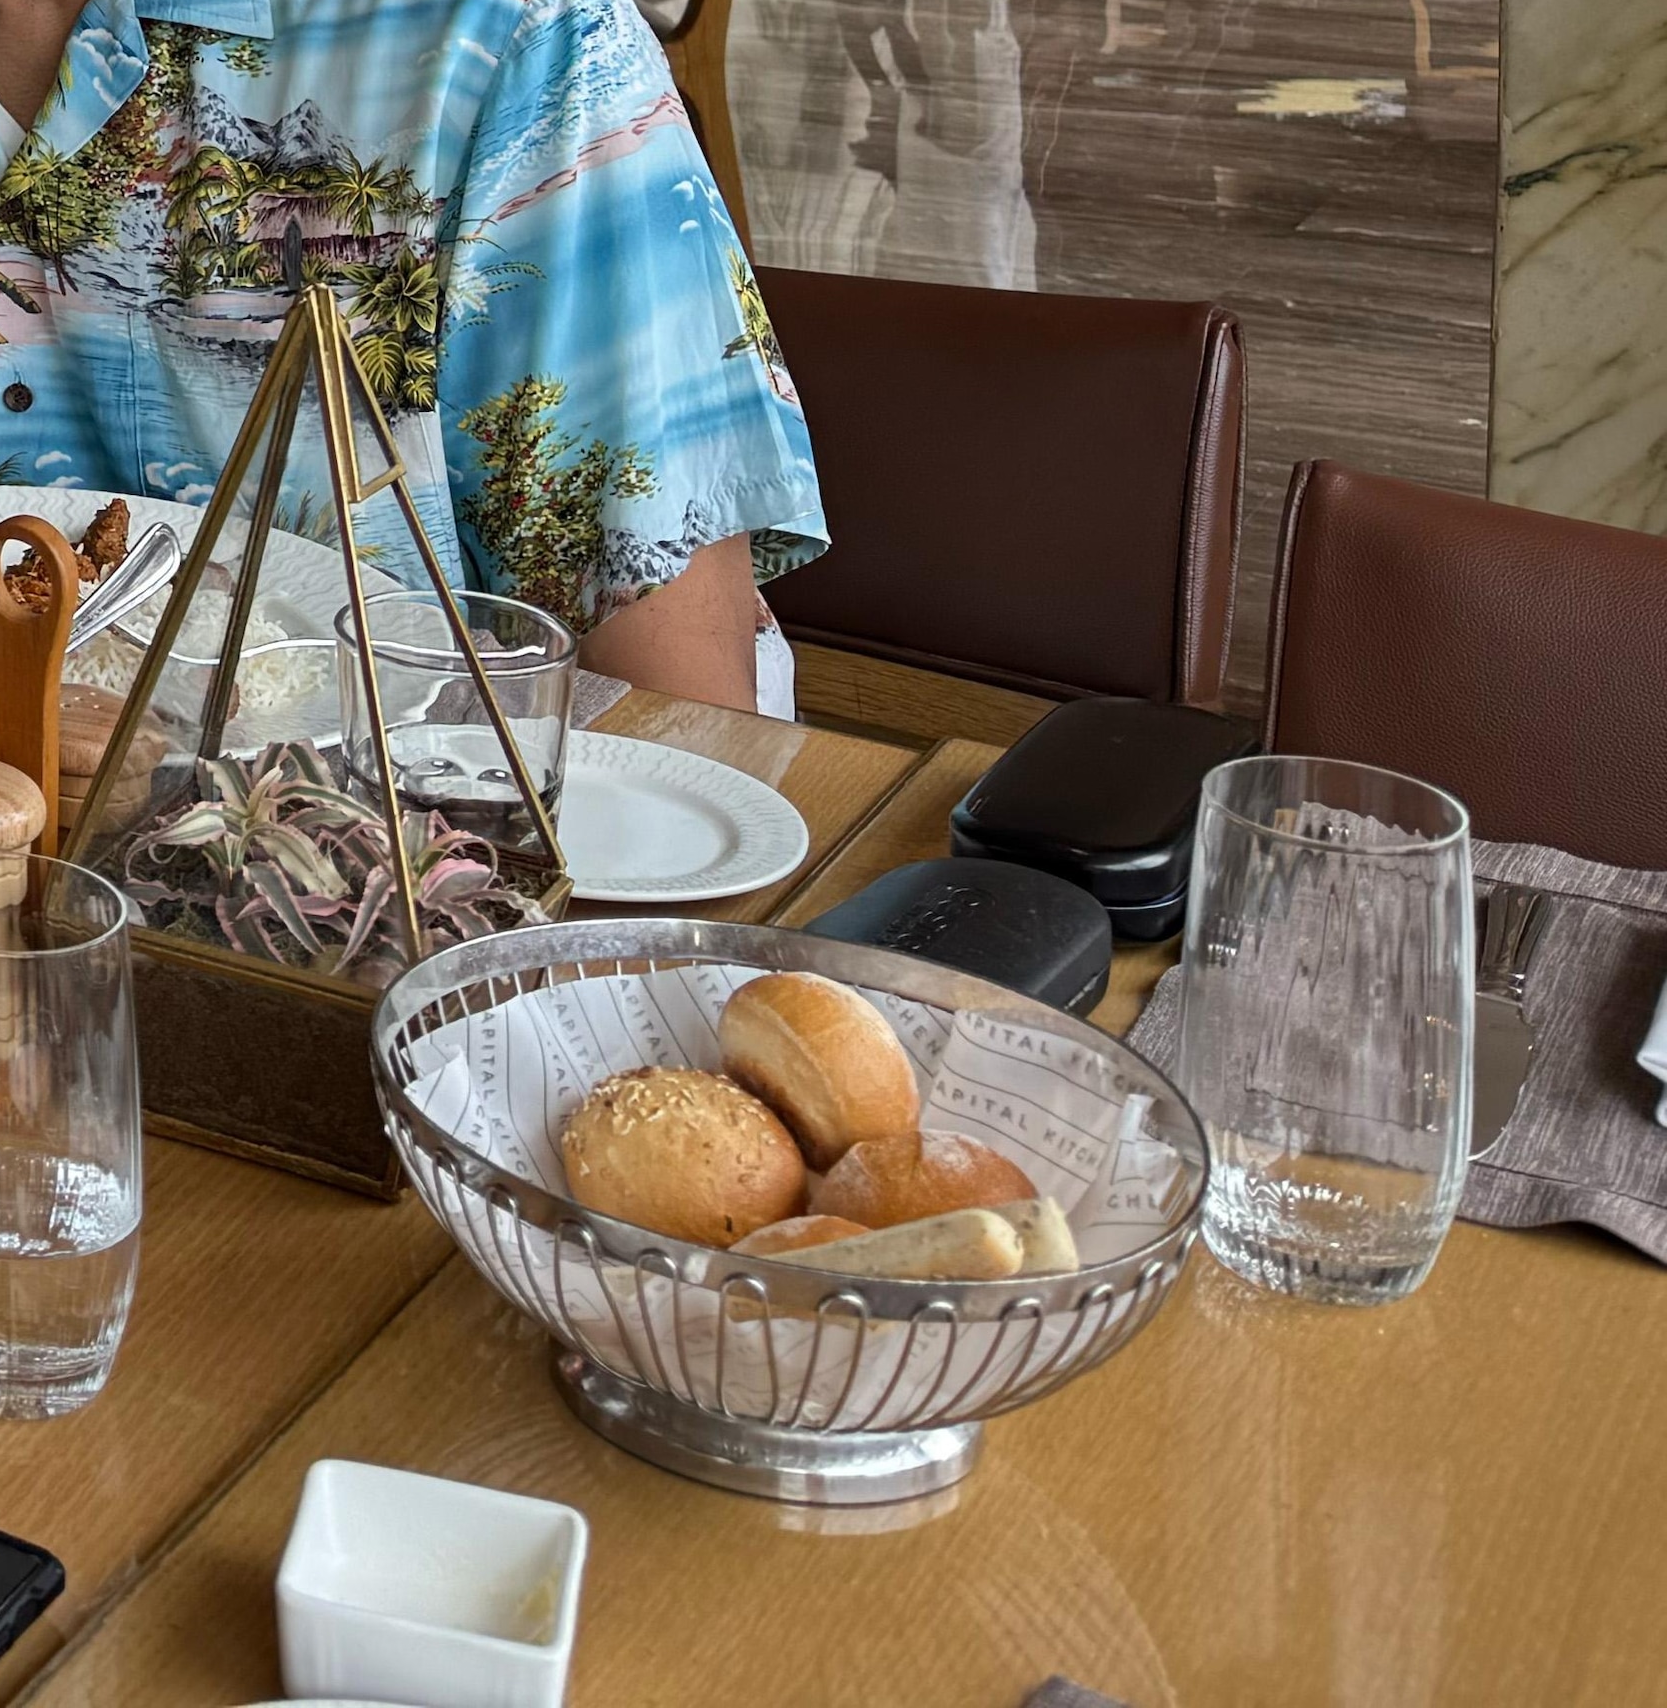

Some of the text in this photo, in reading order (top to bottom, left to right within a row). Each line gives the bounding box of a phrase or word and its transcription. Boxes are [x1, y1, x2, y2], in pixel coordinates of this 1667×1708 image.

[480, 1011, 497, 1099] APITAL
[619, 978, 668, 1065] APITAL
[886, 995, 941, 1057] CHEN
[966, 1013, 1051, 1057] PITAL
[935, 1080, 1097, 1168] APITAL KITCH
